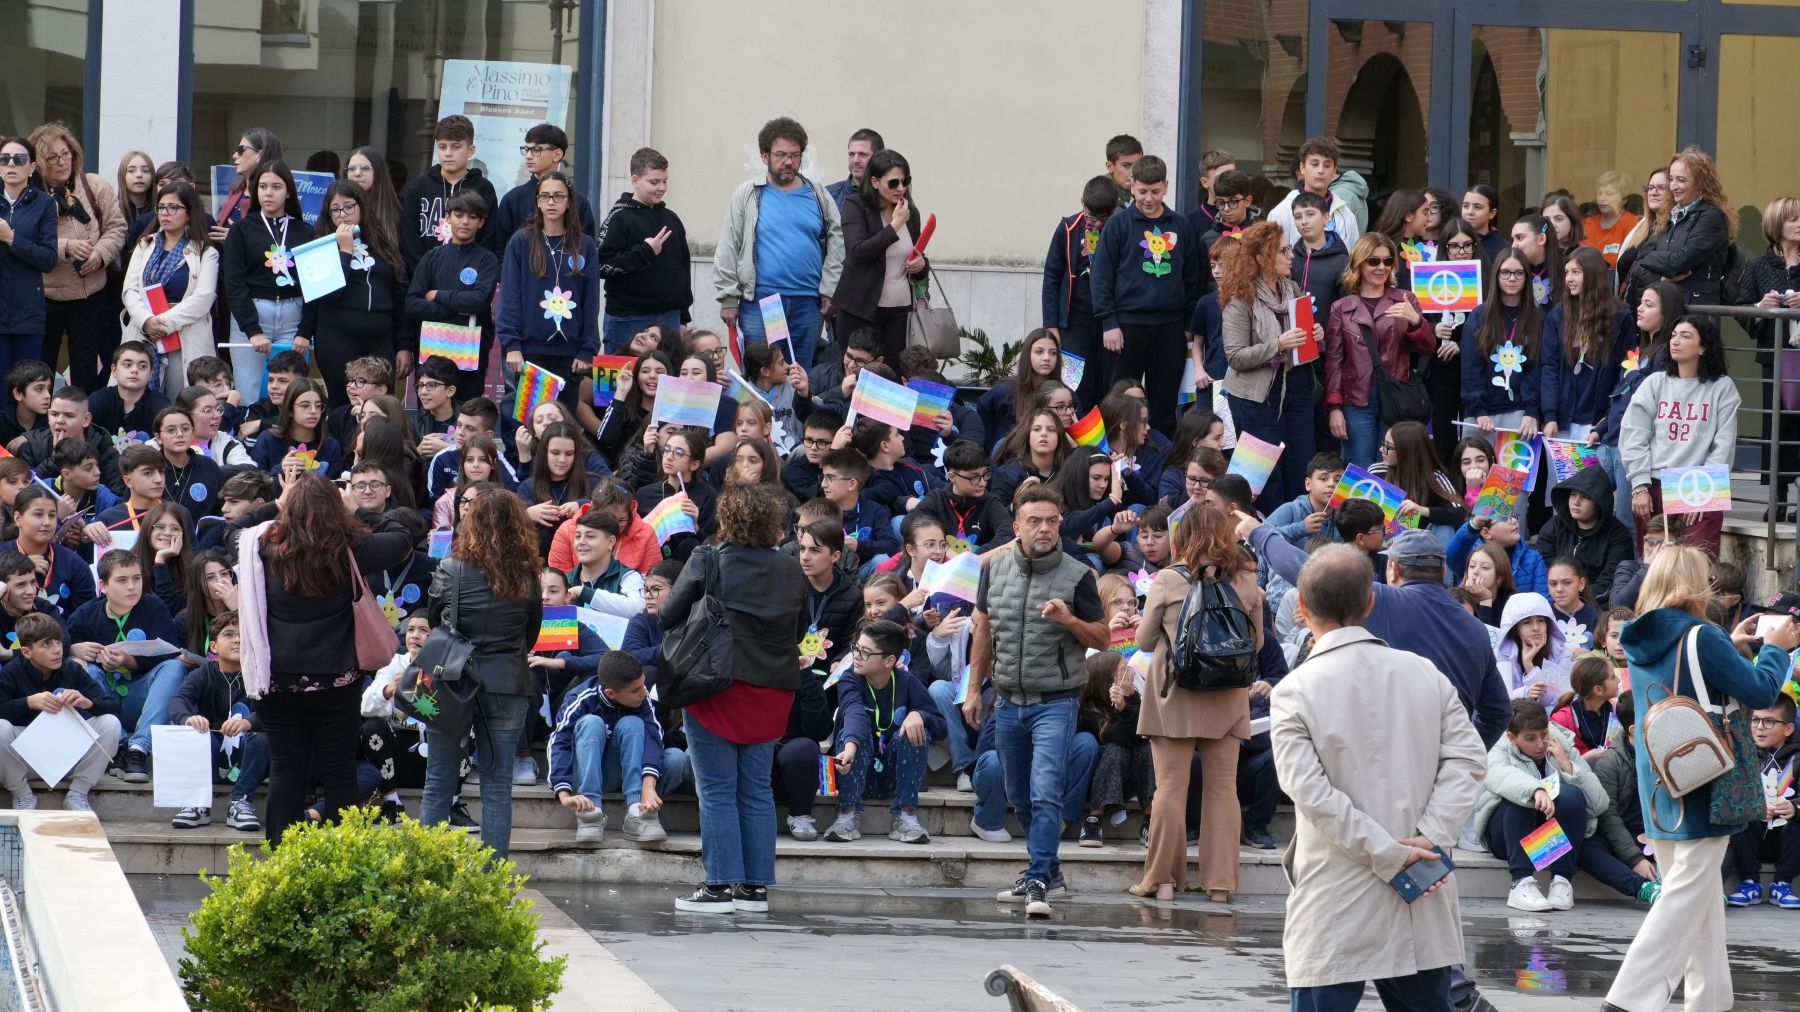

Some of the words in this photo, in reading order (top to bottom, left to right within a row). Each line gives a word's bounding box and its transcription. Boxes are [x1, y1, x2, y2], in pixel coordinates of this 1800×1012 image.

[474, 64, 551, 87] Massimo
[482, 83, 519, 102] Pino
[295, 179, 328, 195] Mosca
[597, 366, 618, 393] PE
[1657, 400, 1710, 422] CALI
[1668, 422, 1691, 442] 92
